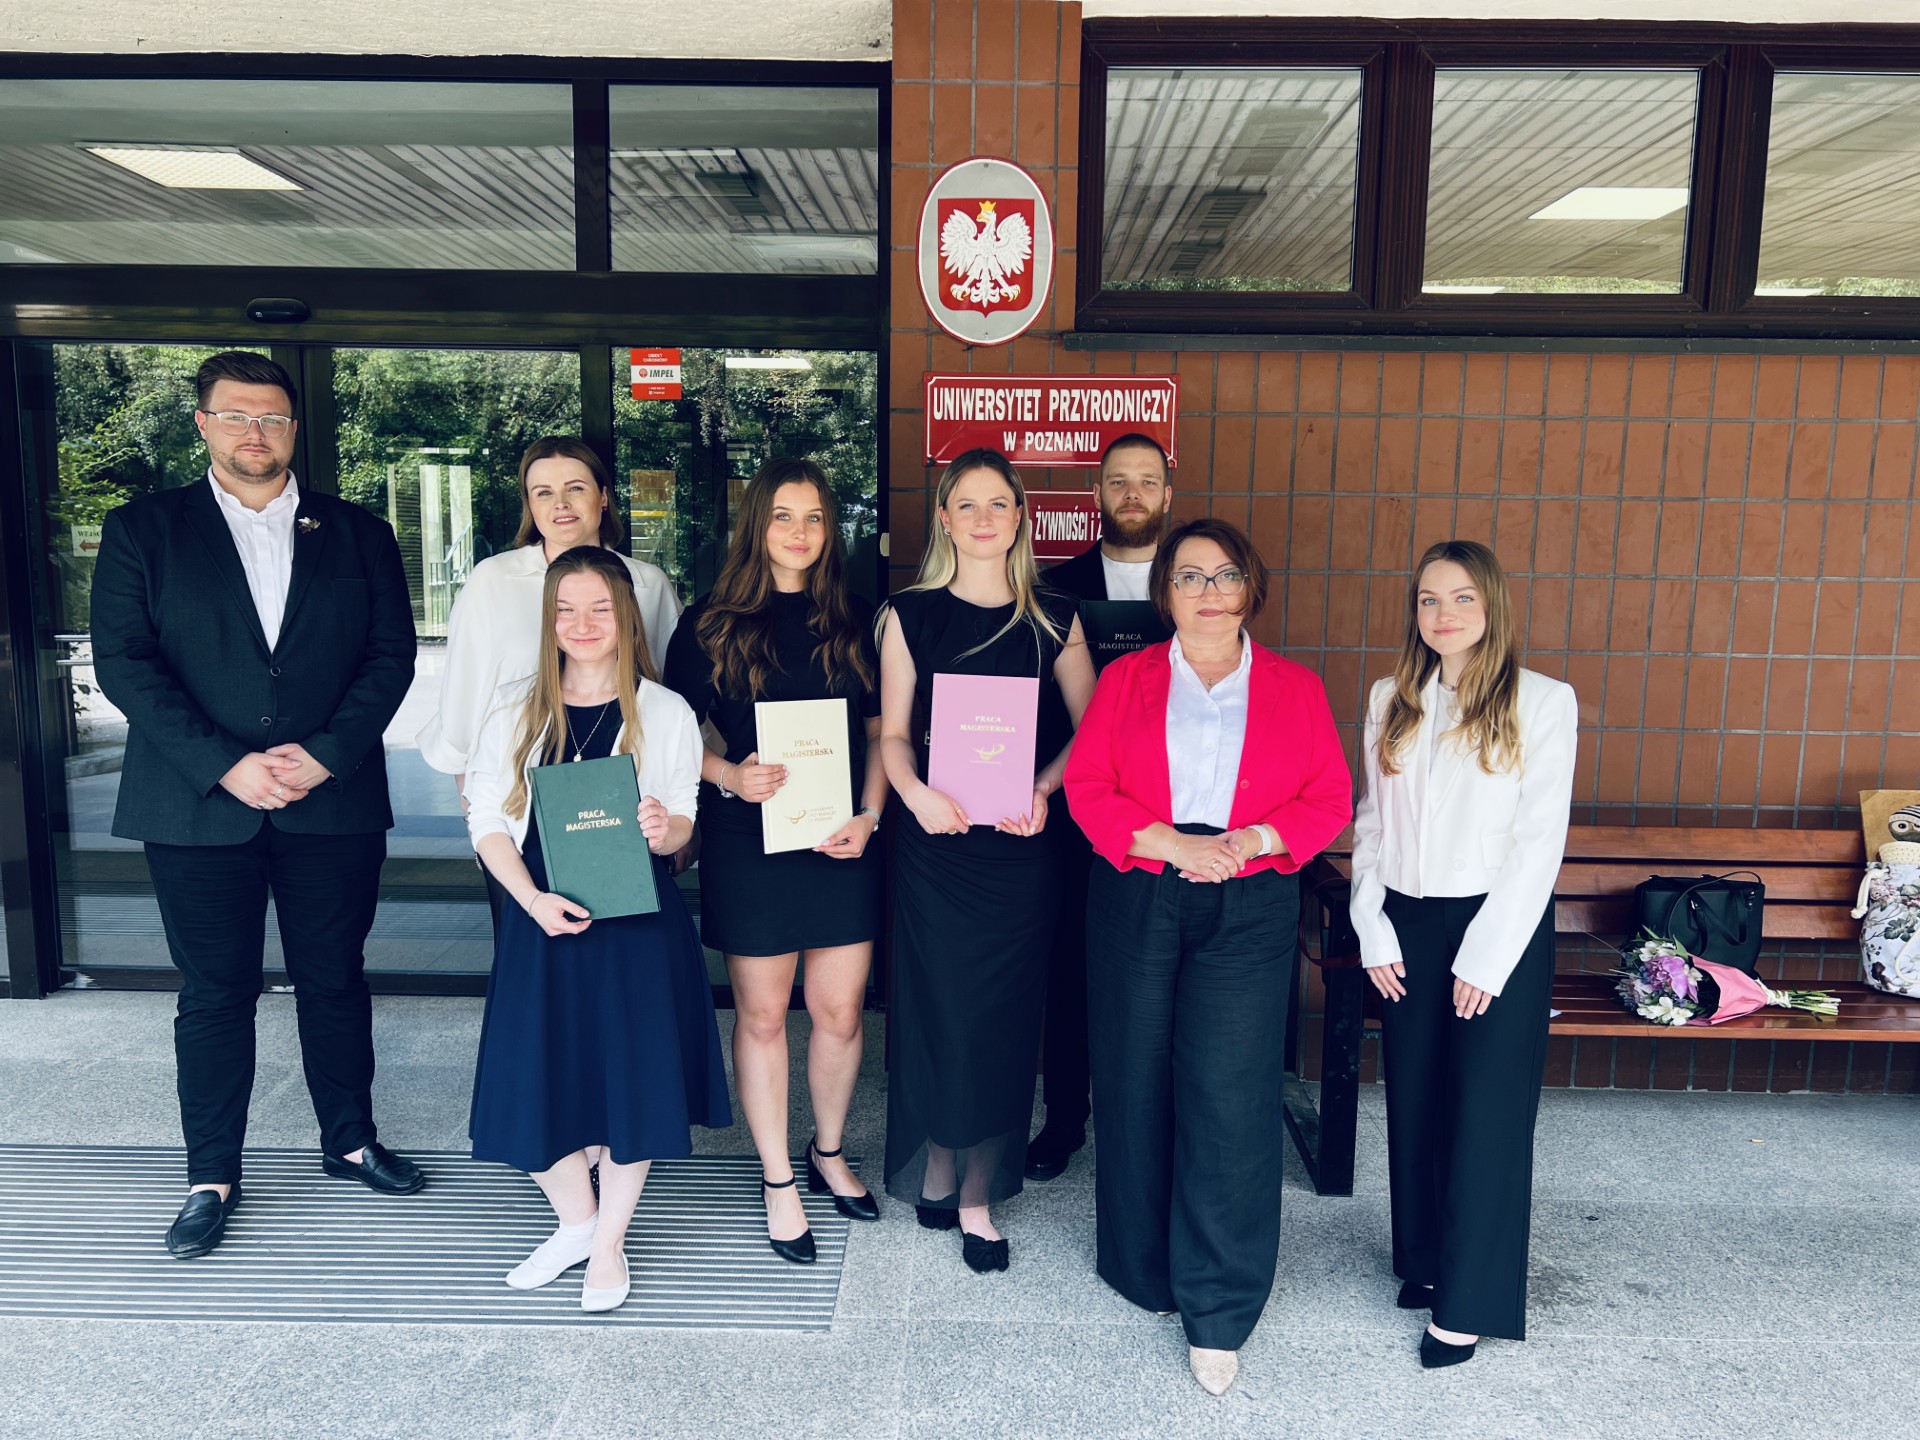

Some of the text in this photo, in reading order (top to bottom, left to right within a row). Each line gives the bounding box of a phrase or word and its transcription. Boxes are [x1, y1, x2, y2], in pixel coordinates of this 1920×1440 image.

[649, 369, 674, 378] IMPEL
[933, 387, 1171, 422] UNIWERSYTET PRZYRODNICZY
[1003, 431, 1100, 452] W POZNANIU
[1035, 505, 1088, 541] ŻYWNOŚCI
[1114, 633, 1142, 641] PRACA
[975, 715, 1002, 723] PRACA
[959, 724, 1016, 733] MAGISTERSKA
[794, 738, 820, 747] PRACA
[781, 748, 834, 758] MAGISTERSKA
[578, 809, 606, 820] PRACA
[565, 817, 622, 832] MAGISTERSKA
